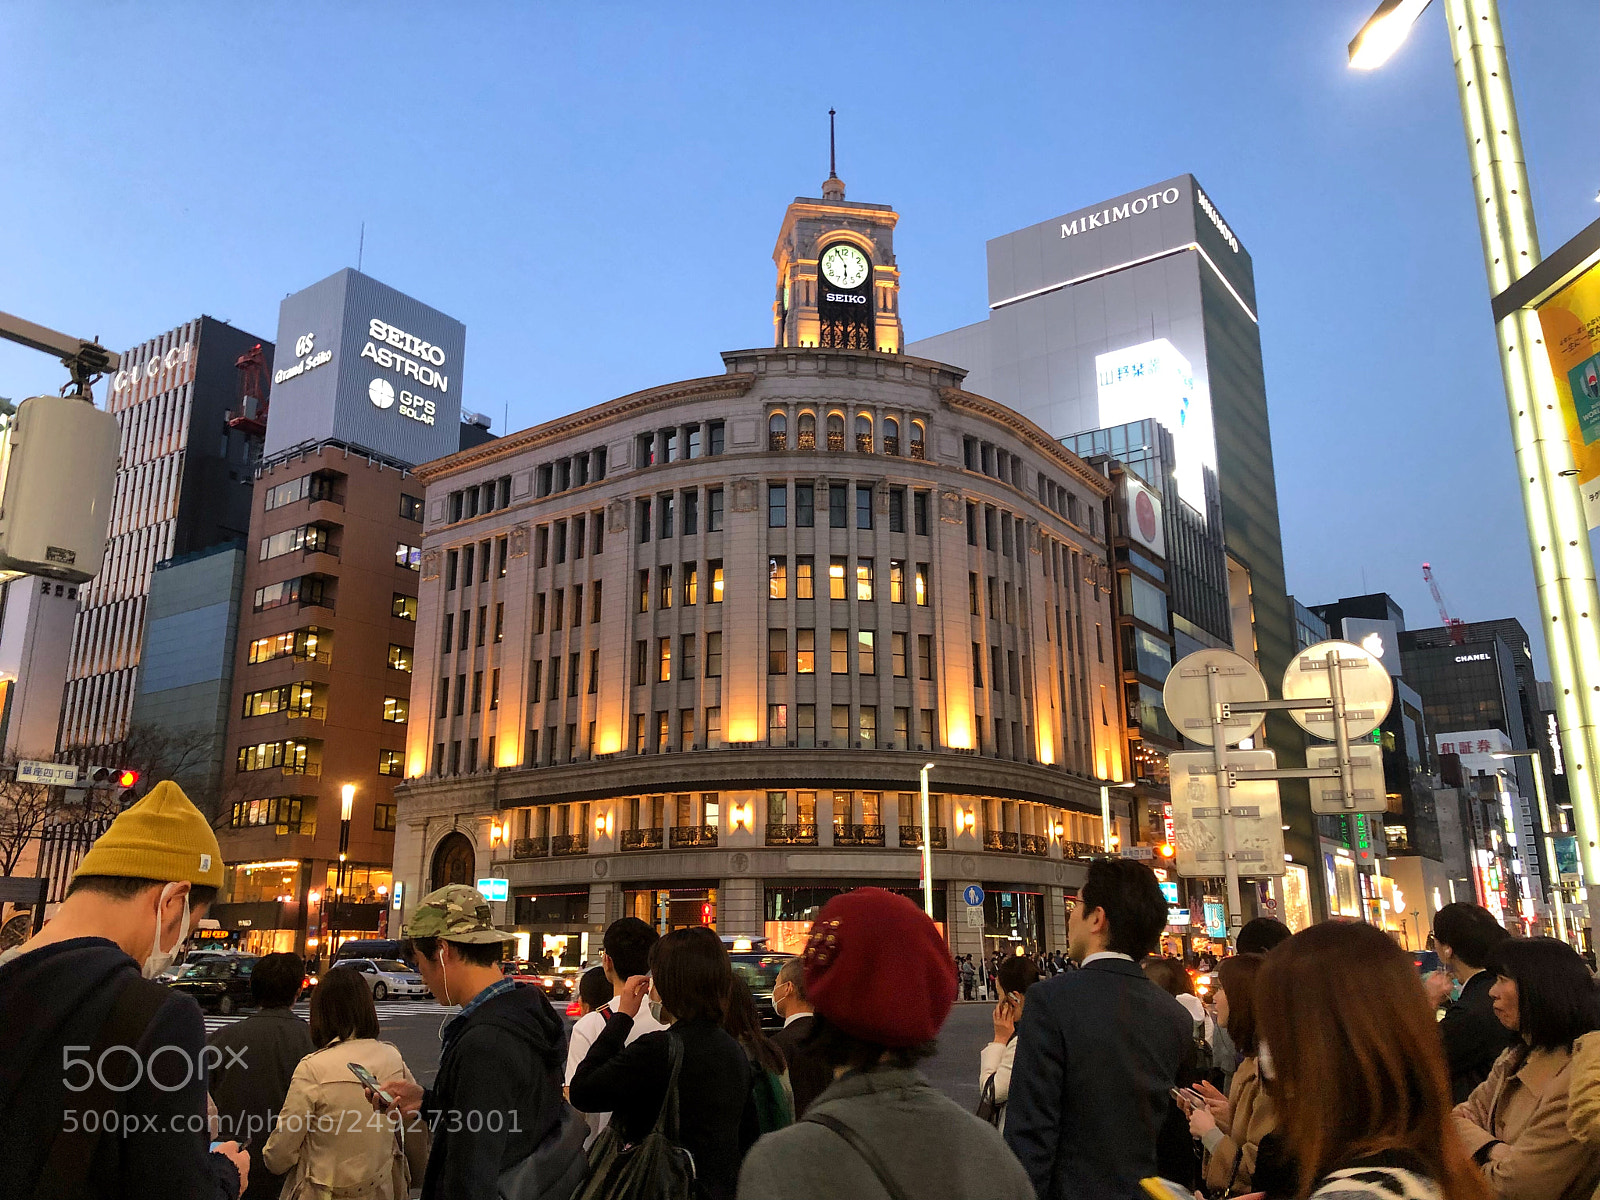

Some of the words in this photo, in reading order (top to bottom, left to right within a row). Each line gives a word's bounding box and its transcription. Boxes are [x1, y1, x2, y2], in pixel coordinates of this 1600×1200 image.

[1060, 187, 1180, 239] MIKIMOTO
[1197, 189, 1239, 254] MIKIMOTO
[841, 248, 849, 257] 12
[856, 256, 861, 264] 2
[859, 264, 864, 272] 3
[826, 293, 866, 304] SEIKO
[295, 332, 317, 358] GS
[369, 318, 446, 366] SEIKO
[113, 342, 190, 392] GUCCI
[274, 360, 304, 384] Grand
[304, 350, 332, 371] Seiko
[360, 342, 448, 393] ASTRON
[399, 390, 436, 415] GPS
[398, 405, 435, 426] SOLAR
[1455, 653, 1491, 663] CHANEL
[22, 765, 74, 780] 銀座四丁目
